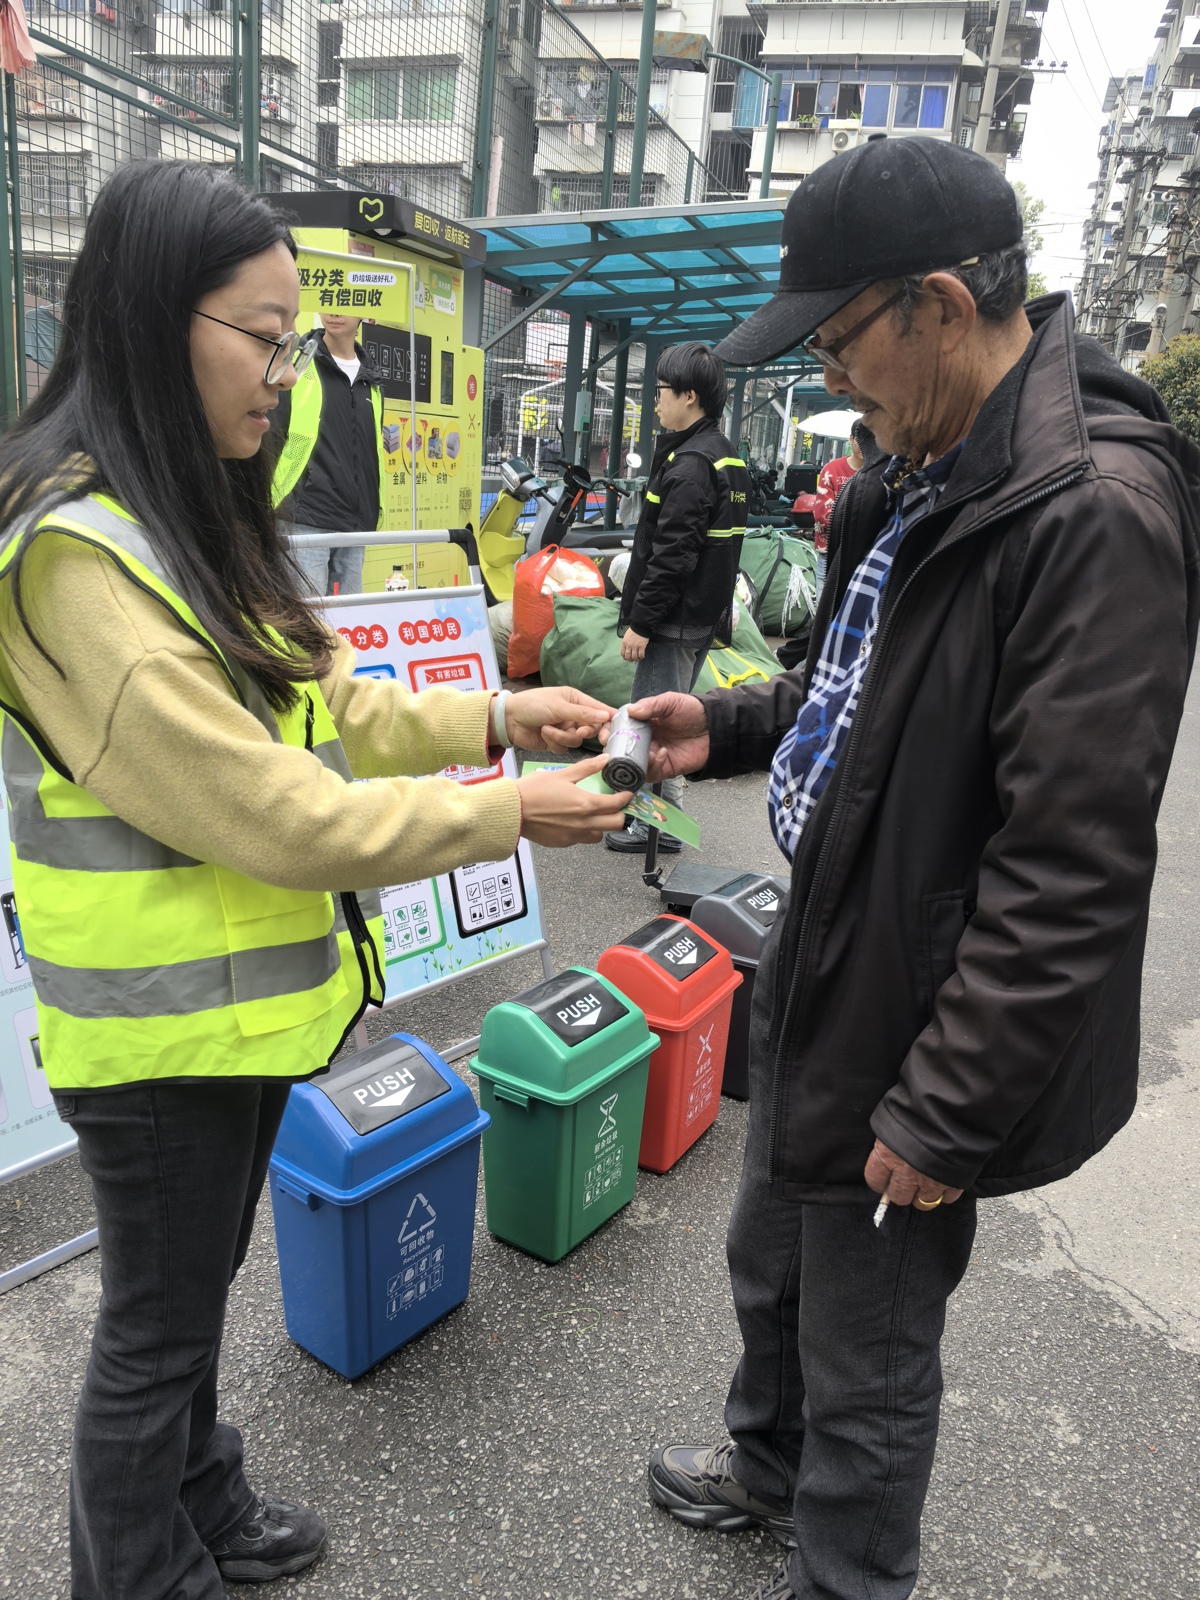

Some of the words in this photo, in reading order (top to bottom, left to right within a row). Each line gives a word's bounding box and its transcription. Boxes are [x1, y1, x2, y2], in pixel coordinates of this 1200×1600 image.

[319, 288, 383, 307] 有偿回收
[402, 622, 458, 640] 利国利民
[436, 668, 466, 679] 有害垃圾
[747, 888, 778, 911] PUSH
[664, 936, 696, 964] PUSH
[556, 994, 601, 1025] PUSH
[353, 1067, 416, 1105] PUSH
[400, 1230, 434, 1257] 可回收物
[402, 1244, 431, 1265] Recyclable
